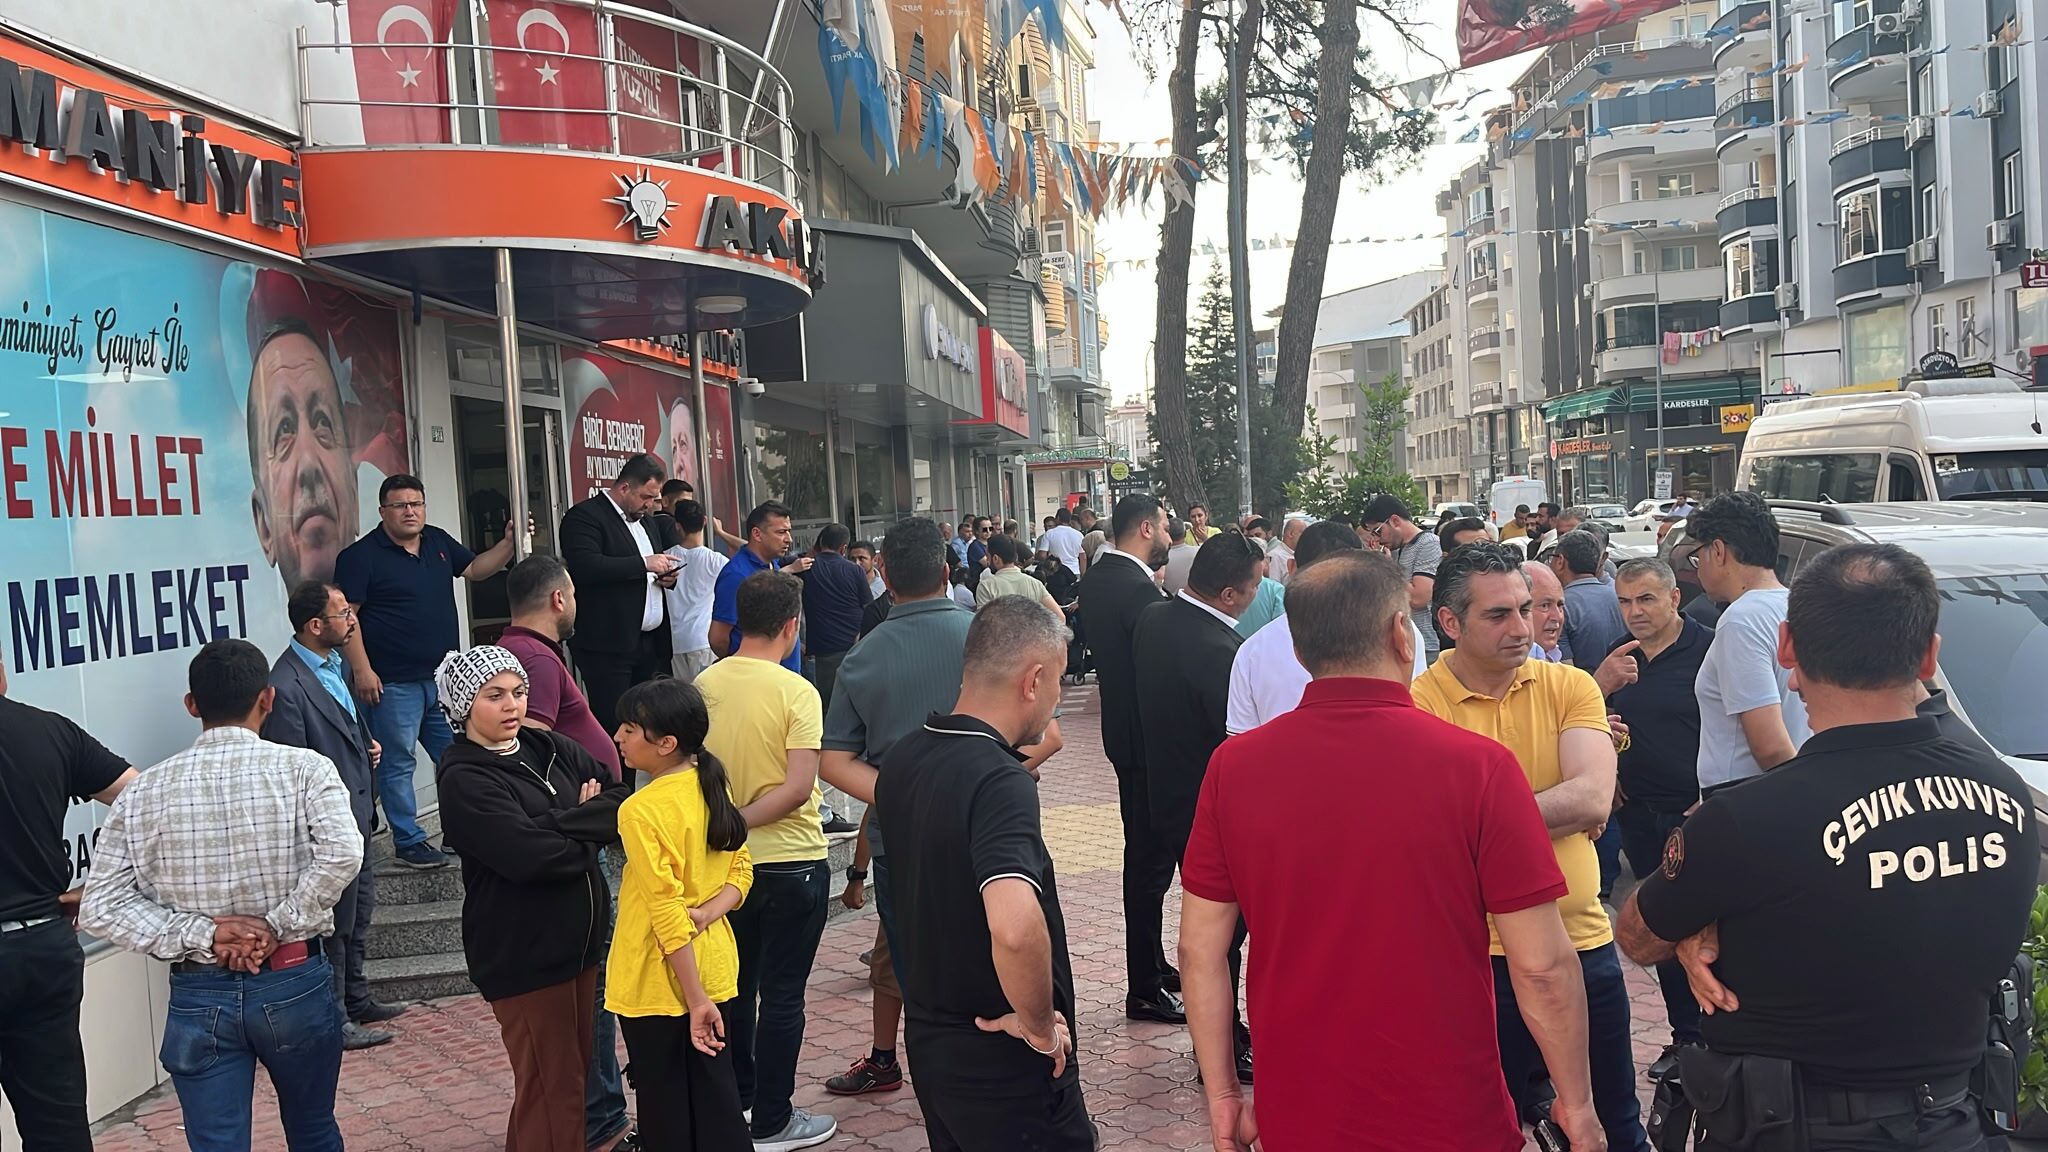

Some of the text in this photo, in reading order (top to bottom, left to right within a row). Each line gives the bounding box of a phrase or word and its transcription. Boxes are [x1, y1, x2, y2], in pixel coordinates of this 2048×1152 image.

[95, 307, 159, 383] Gayret
[162, 302, 190, 373] İle
[606, 419, 647, 453] BERABERİZ
[1664, 399, 1709, 409] KARDEŞLER
[45, 406, 203, 518] MİLLET
[8, 564, 249, 674] MEMLEKET
[1822, 775, 2026, 866] ÇEVİK KUVVET
